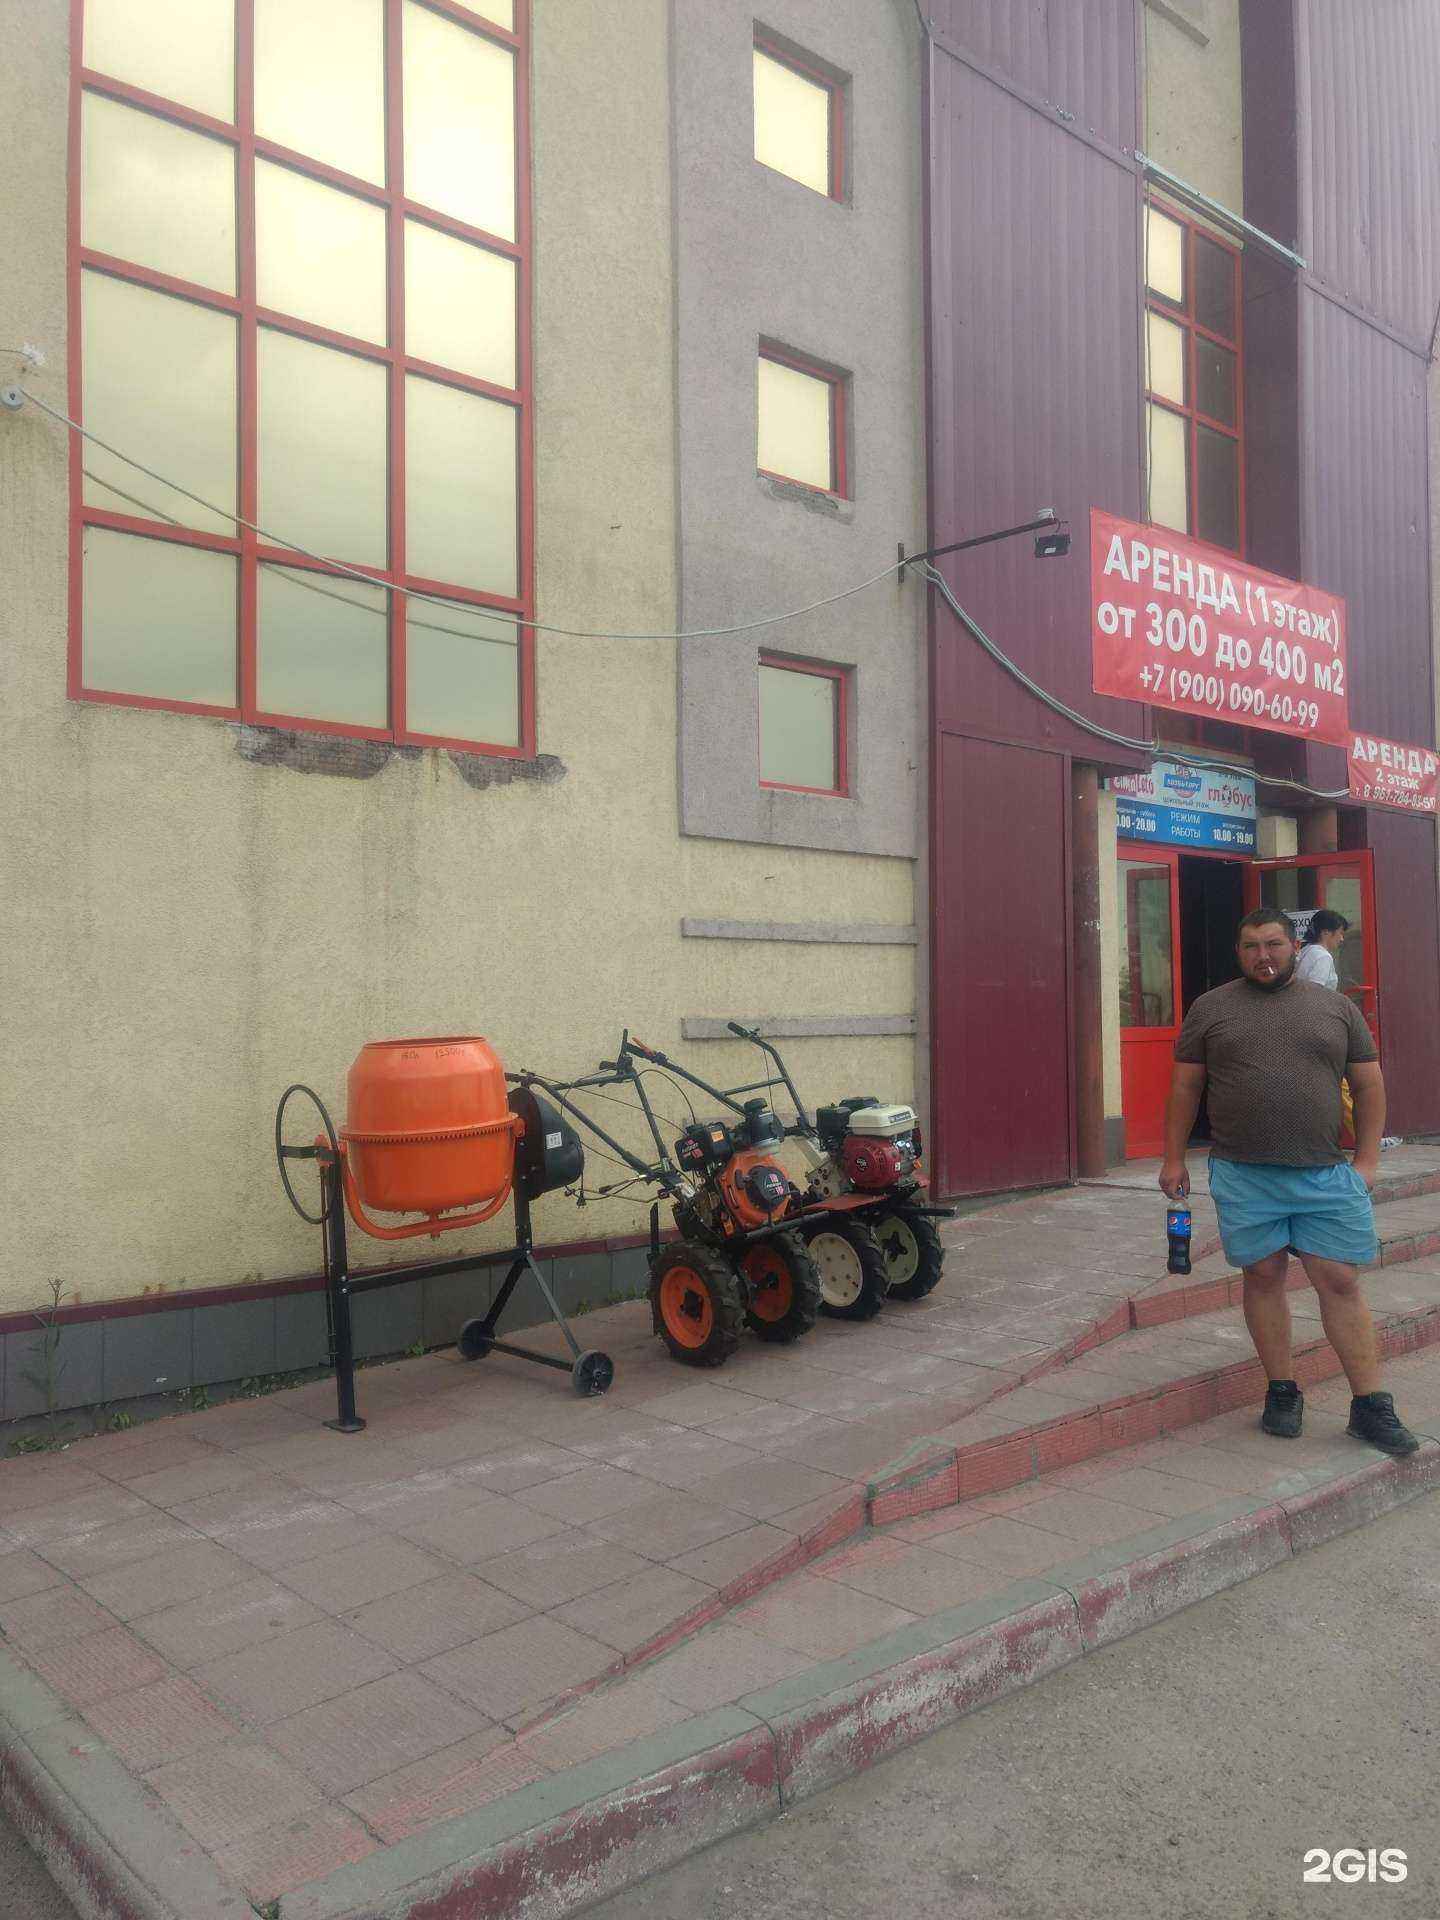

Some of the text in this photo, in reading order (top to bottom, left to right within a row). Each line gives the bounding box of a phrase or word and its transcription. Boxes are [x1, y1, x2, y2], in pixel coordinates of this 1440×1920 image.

[1103, 534, 1241, 616] АРЕНДА
[1097, 602, 1345, 697] от 300 до 400 м2
[1139, 663, 1320, 728] +7 (900) 090-60-99
[1352, 736, 1437, 778] АРЕНДА
[1375, 767, 1420, 791] 2 этаж
[1170, 810, 1201, 825] РЕЖИМ
[1171, 824, 1201, 839] РАБОТЫ
